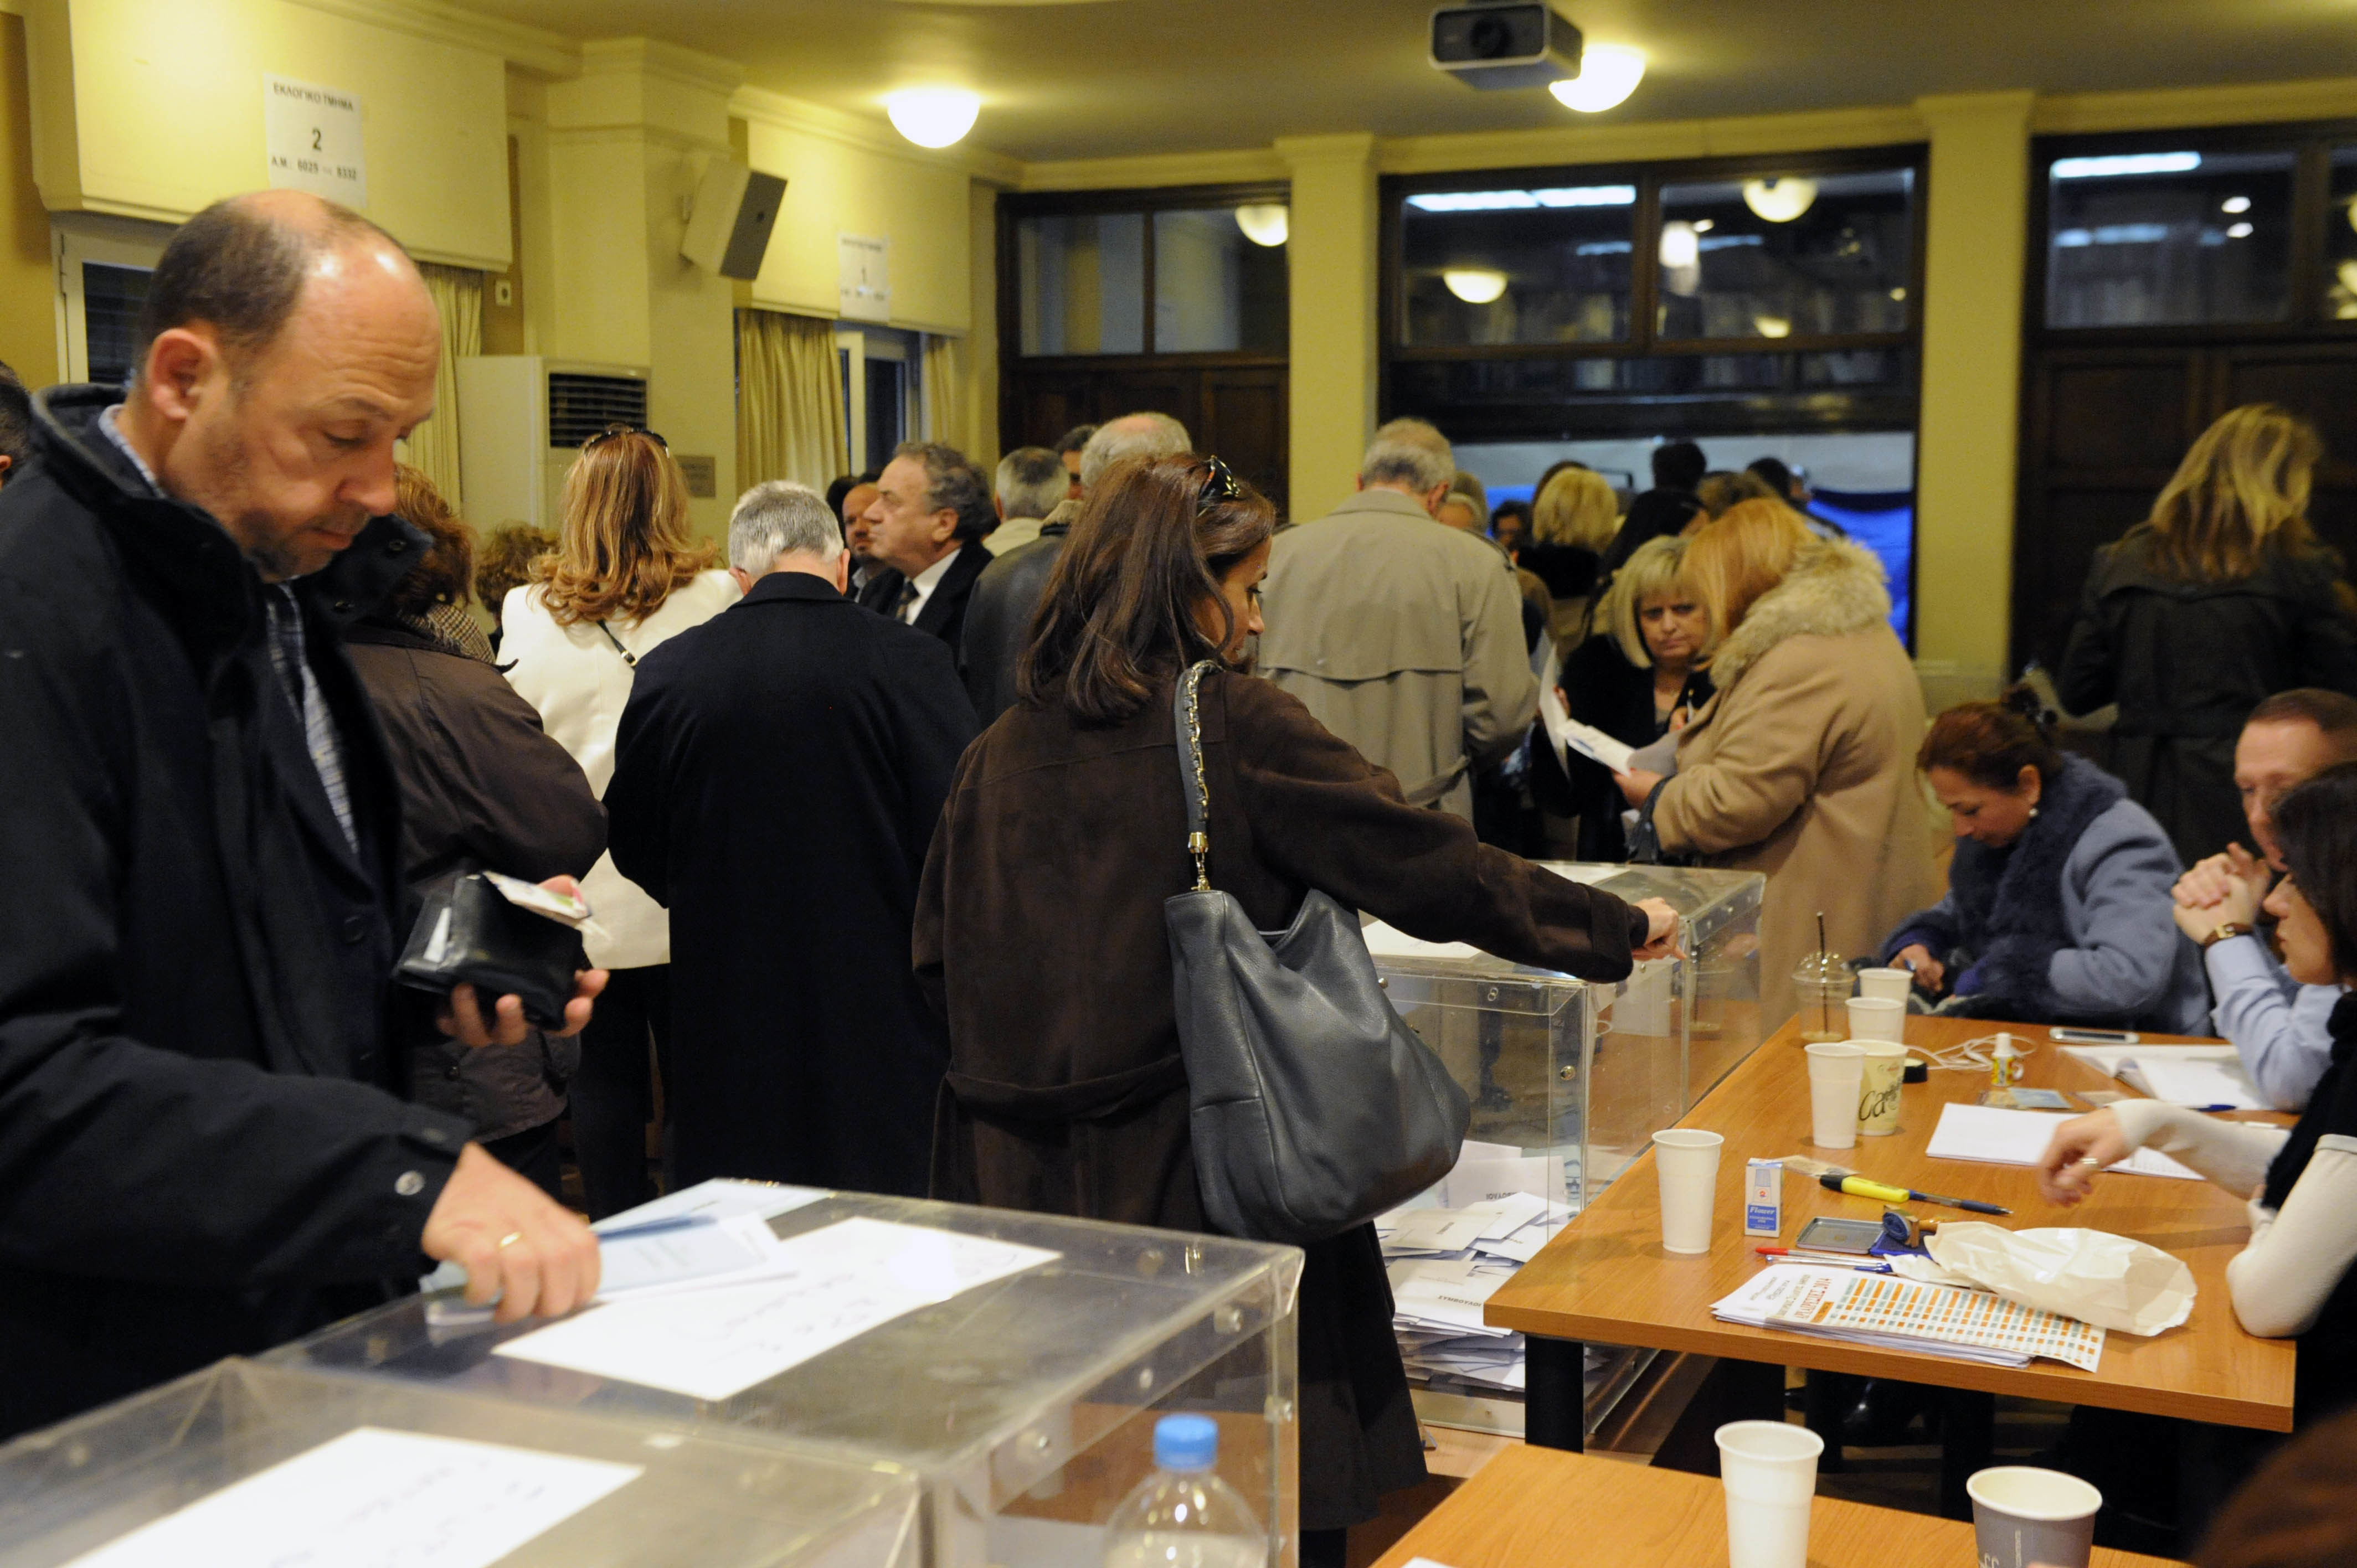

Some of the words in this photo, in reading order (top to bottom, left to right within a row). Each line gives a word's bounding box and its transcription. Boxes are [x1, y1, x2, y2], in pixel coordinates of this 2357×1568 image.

[274, 82, 321, 105] ΕΚΛΟΓΙΚΟ
[323, 93, 354, 111] ΤΜΗΜΑ
[312, 128, 322, 152] 2
[1750, 1206, 1775, 1215] Flower
[1438, 1295, 1482, 1307] ΣΥΜΒΟΥΛΟΙ
